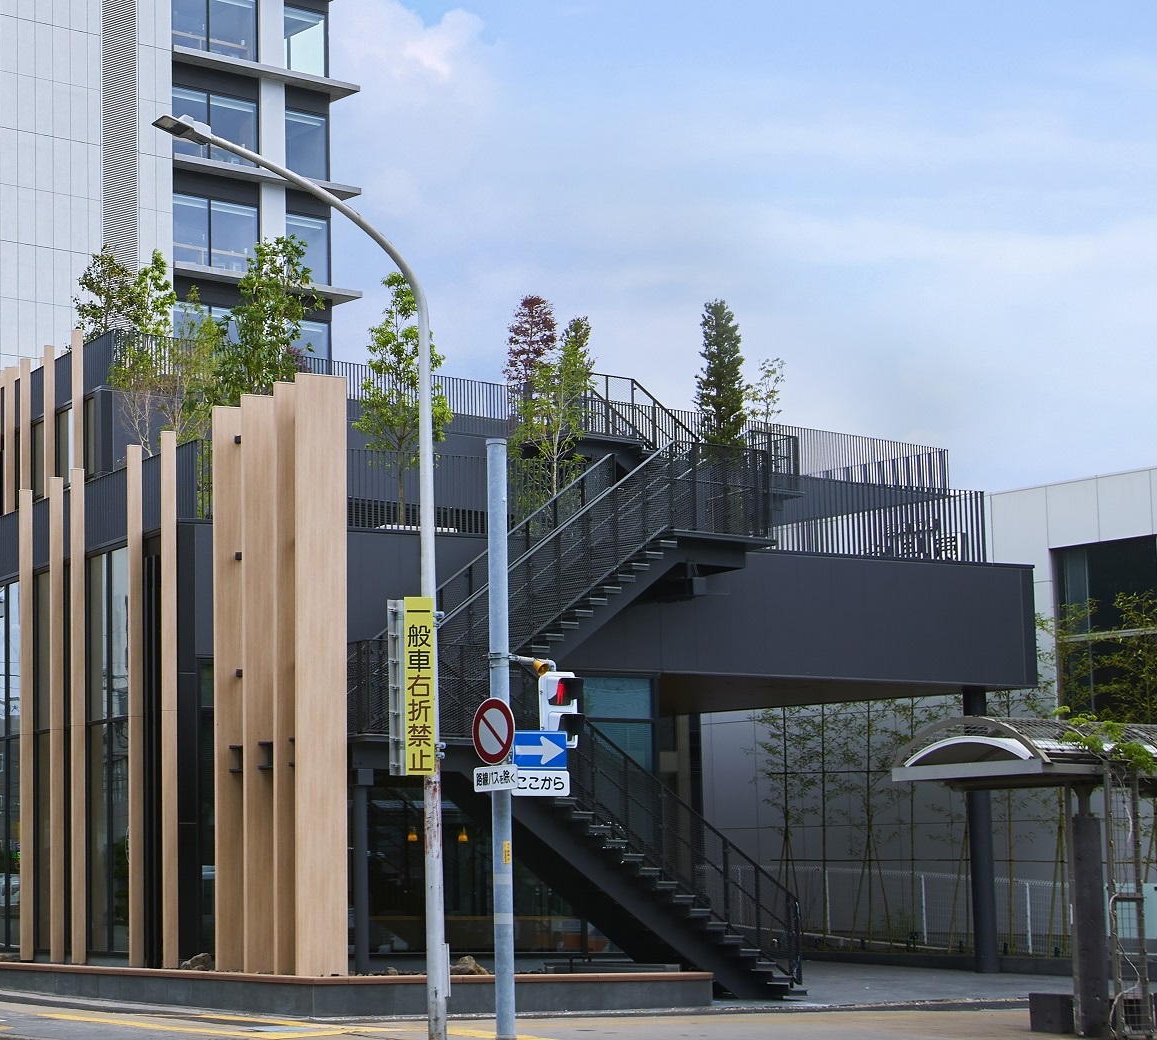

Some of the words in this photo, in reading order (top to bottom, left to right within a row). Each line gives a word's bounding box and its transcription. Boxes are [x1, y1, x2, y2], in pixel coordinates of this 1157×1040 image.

[406, 609, 432, 771] 一般車右折禁止
[476, 770, 516, 787] 路線バスを除く
[517, 776, 565, 791] ここから
